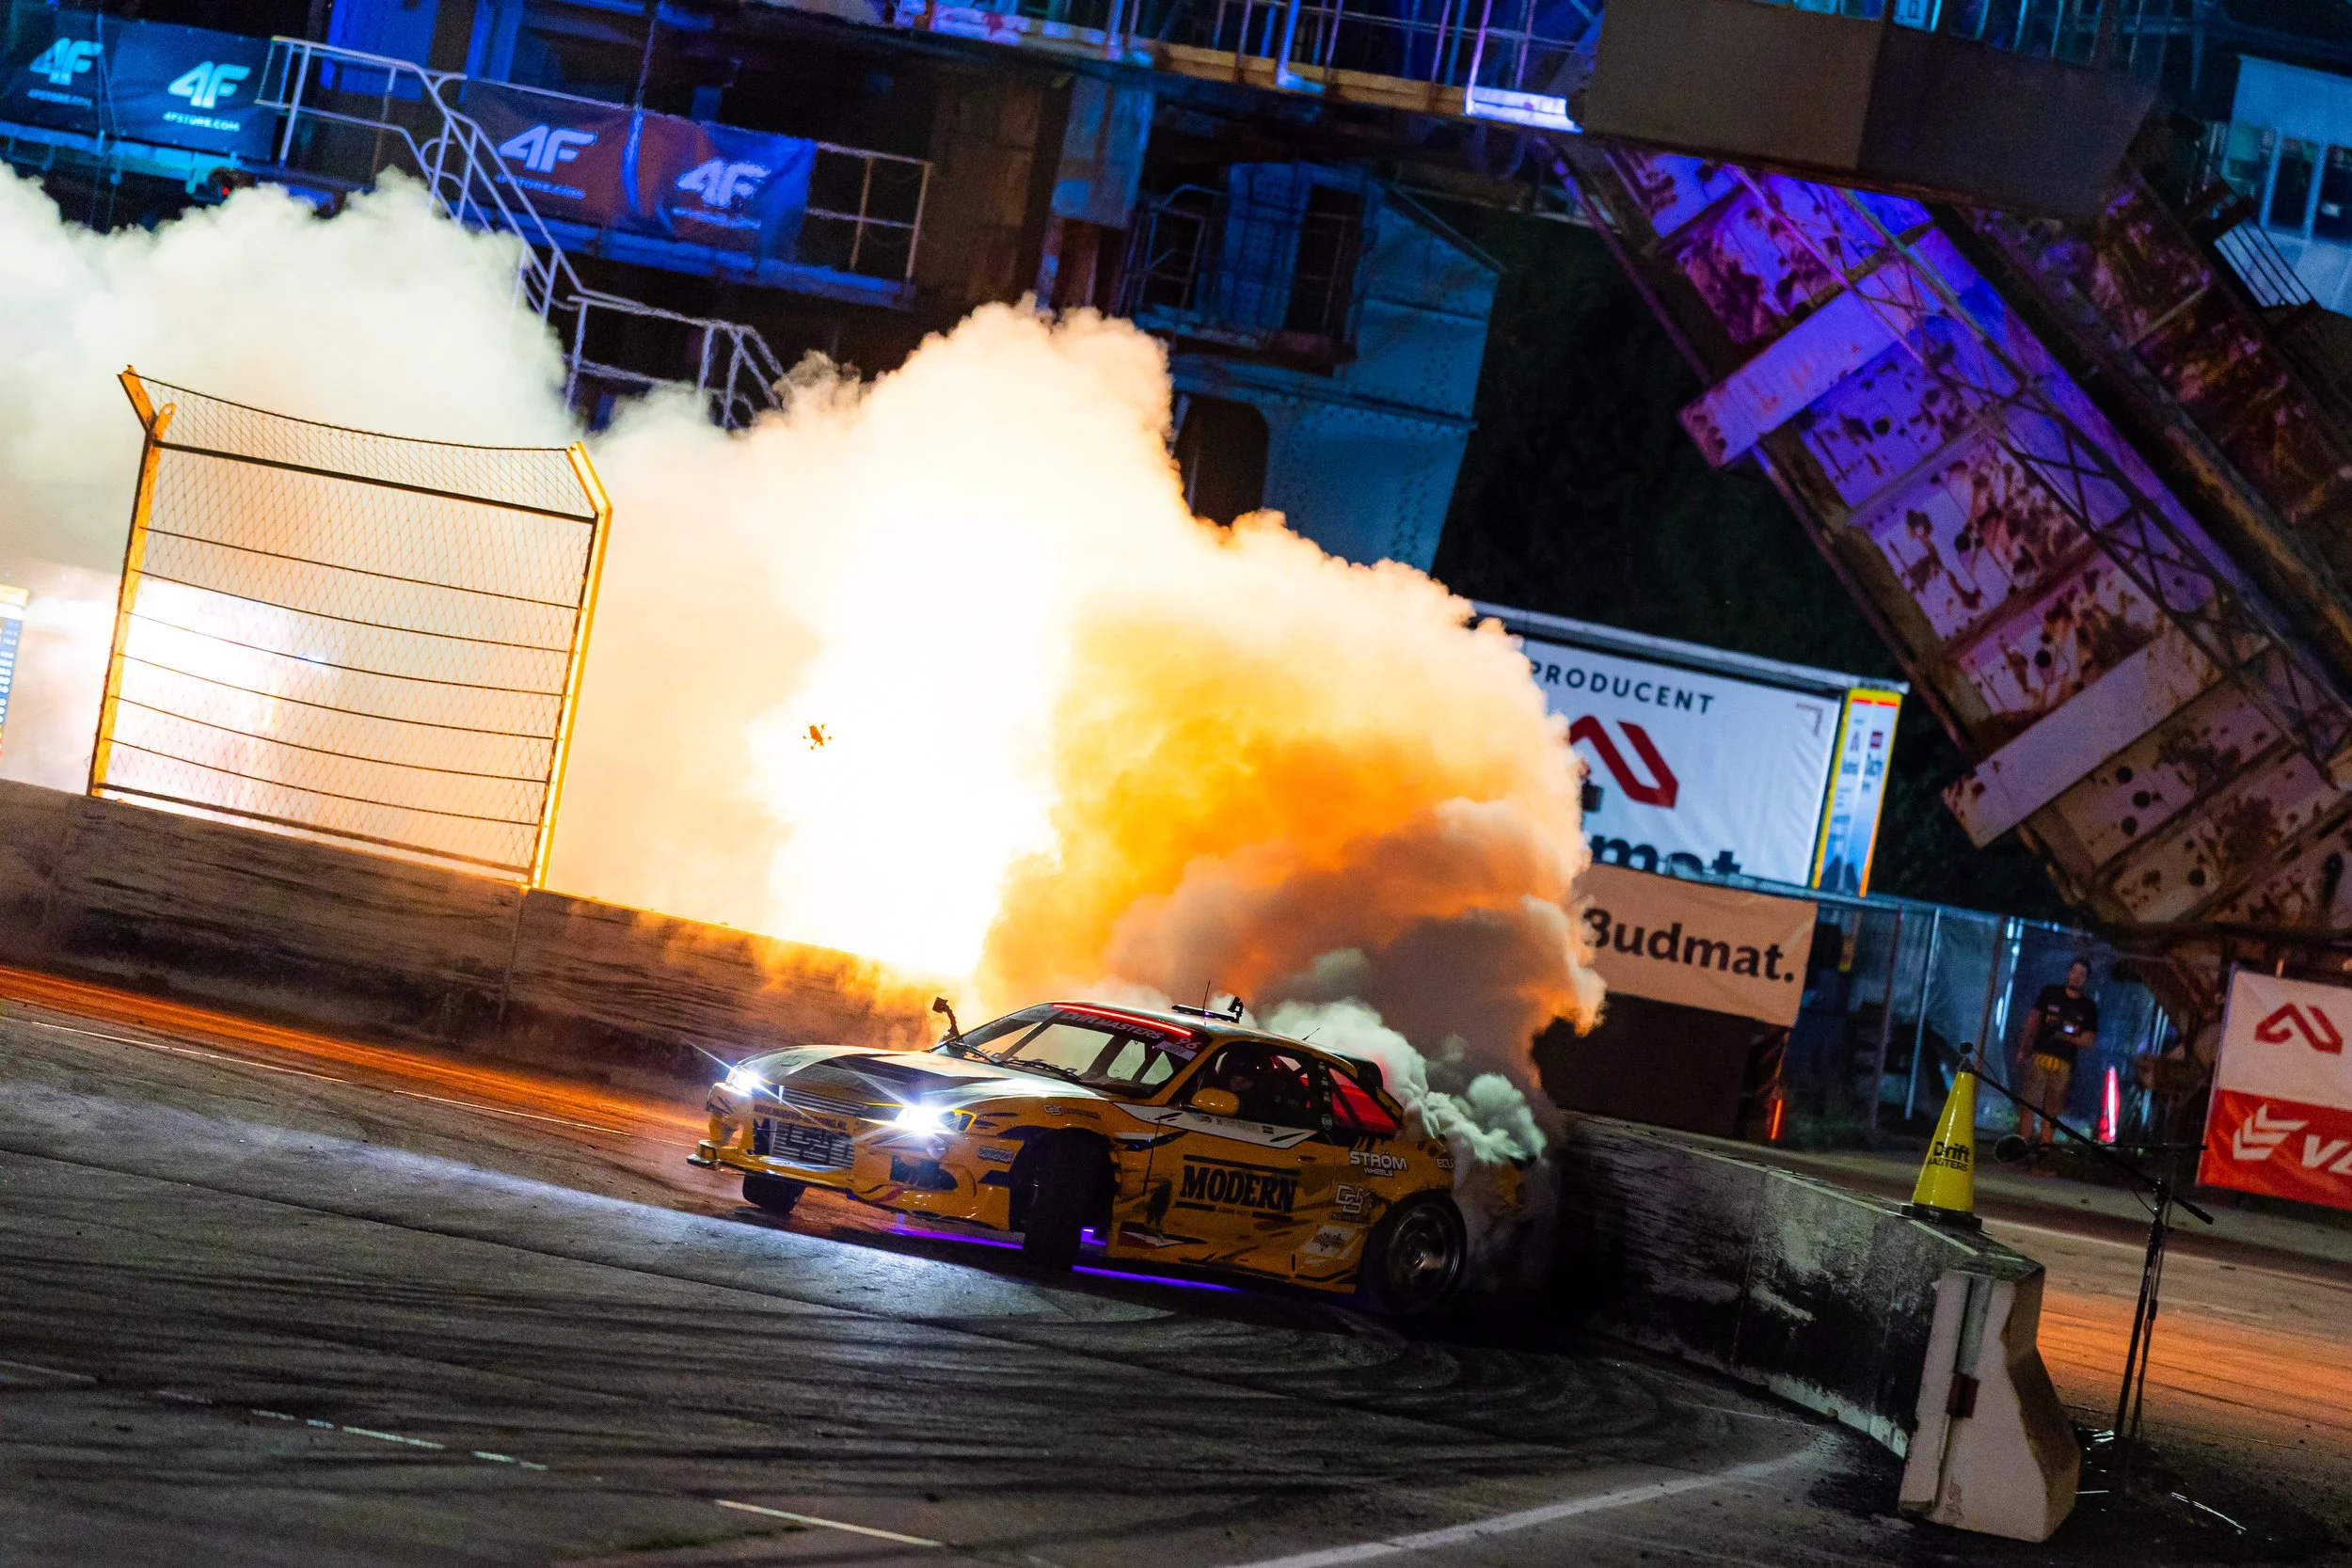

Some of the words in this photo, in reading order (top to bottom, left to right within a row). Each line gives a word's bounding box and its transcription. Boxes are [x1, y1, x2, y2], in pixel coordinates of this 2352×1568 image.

[29, 38, 103, 86] 4F
[167, 60, 251, 109] 4F
[496, 122, 597, 173] 4F
[675, 158, 772, 209] 4F
[1176, 1037, 1202, 1050] 96
[1349, 1149, 1408, 1171] STRÖM
[1180, 1164, 1299, 1213] MODERN
